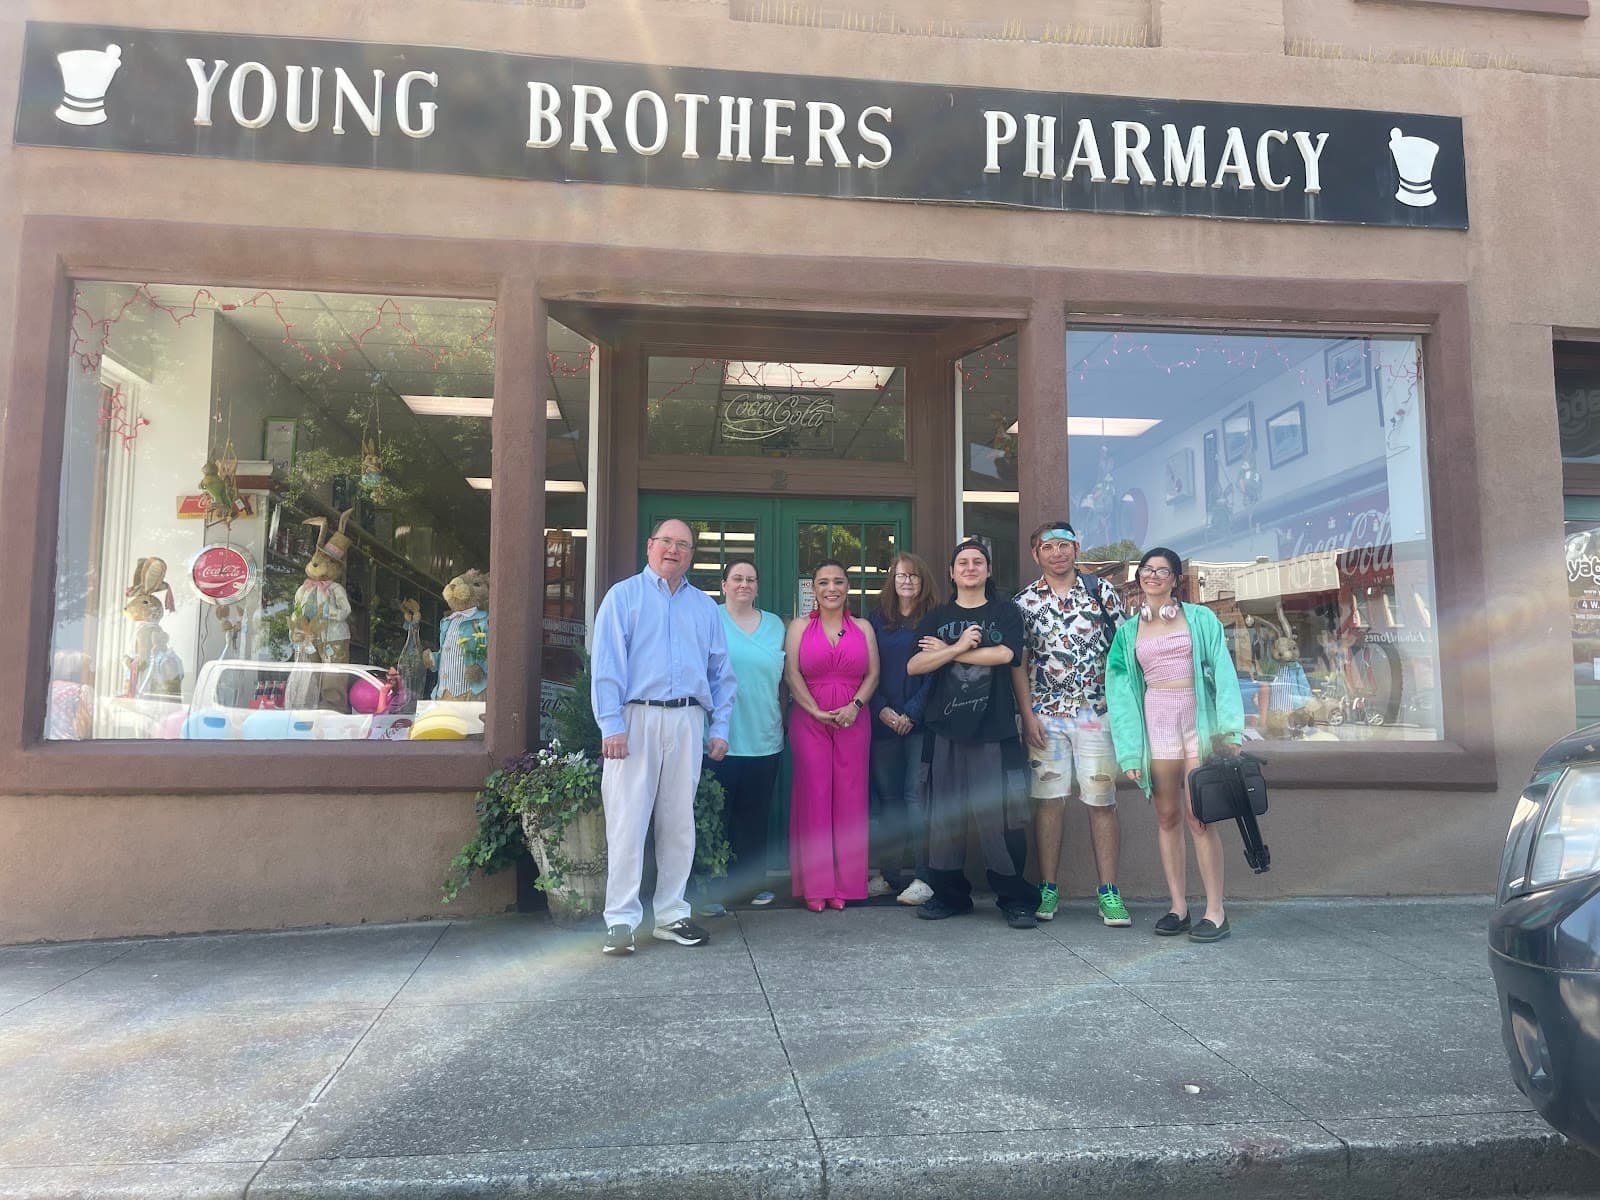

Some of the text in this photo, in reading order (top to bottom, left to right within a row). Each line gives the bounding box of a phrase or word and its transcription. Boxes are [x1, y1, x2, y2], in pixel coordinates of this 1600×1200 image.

[186, 57, 1330, 194] YOUNG BROTHERS PHARMACY
